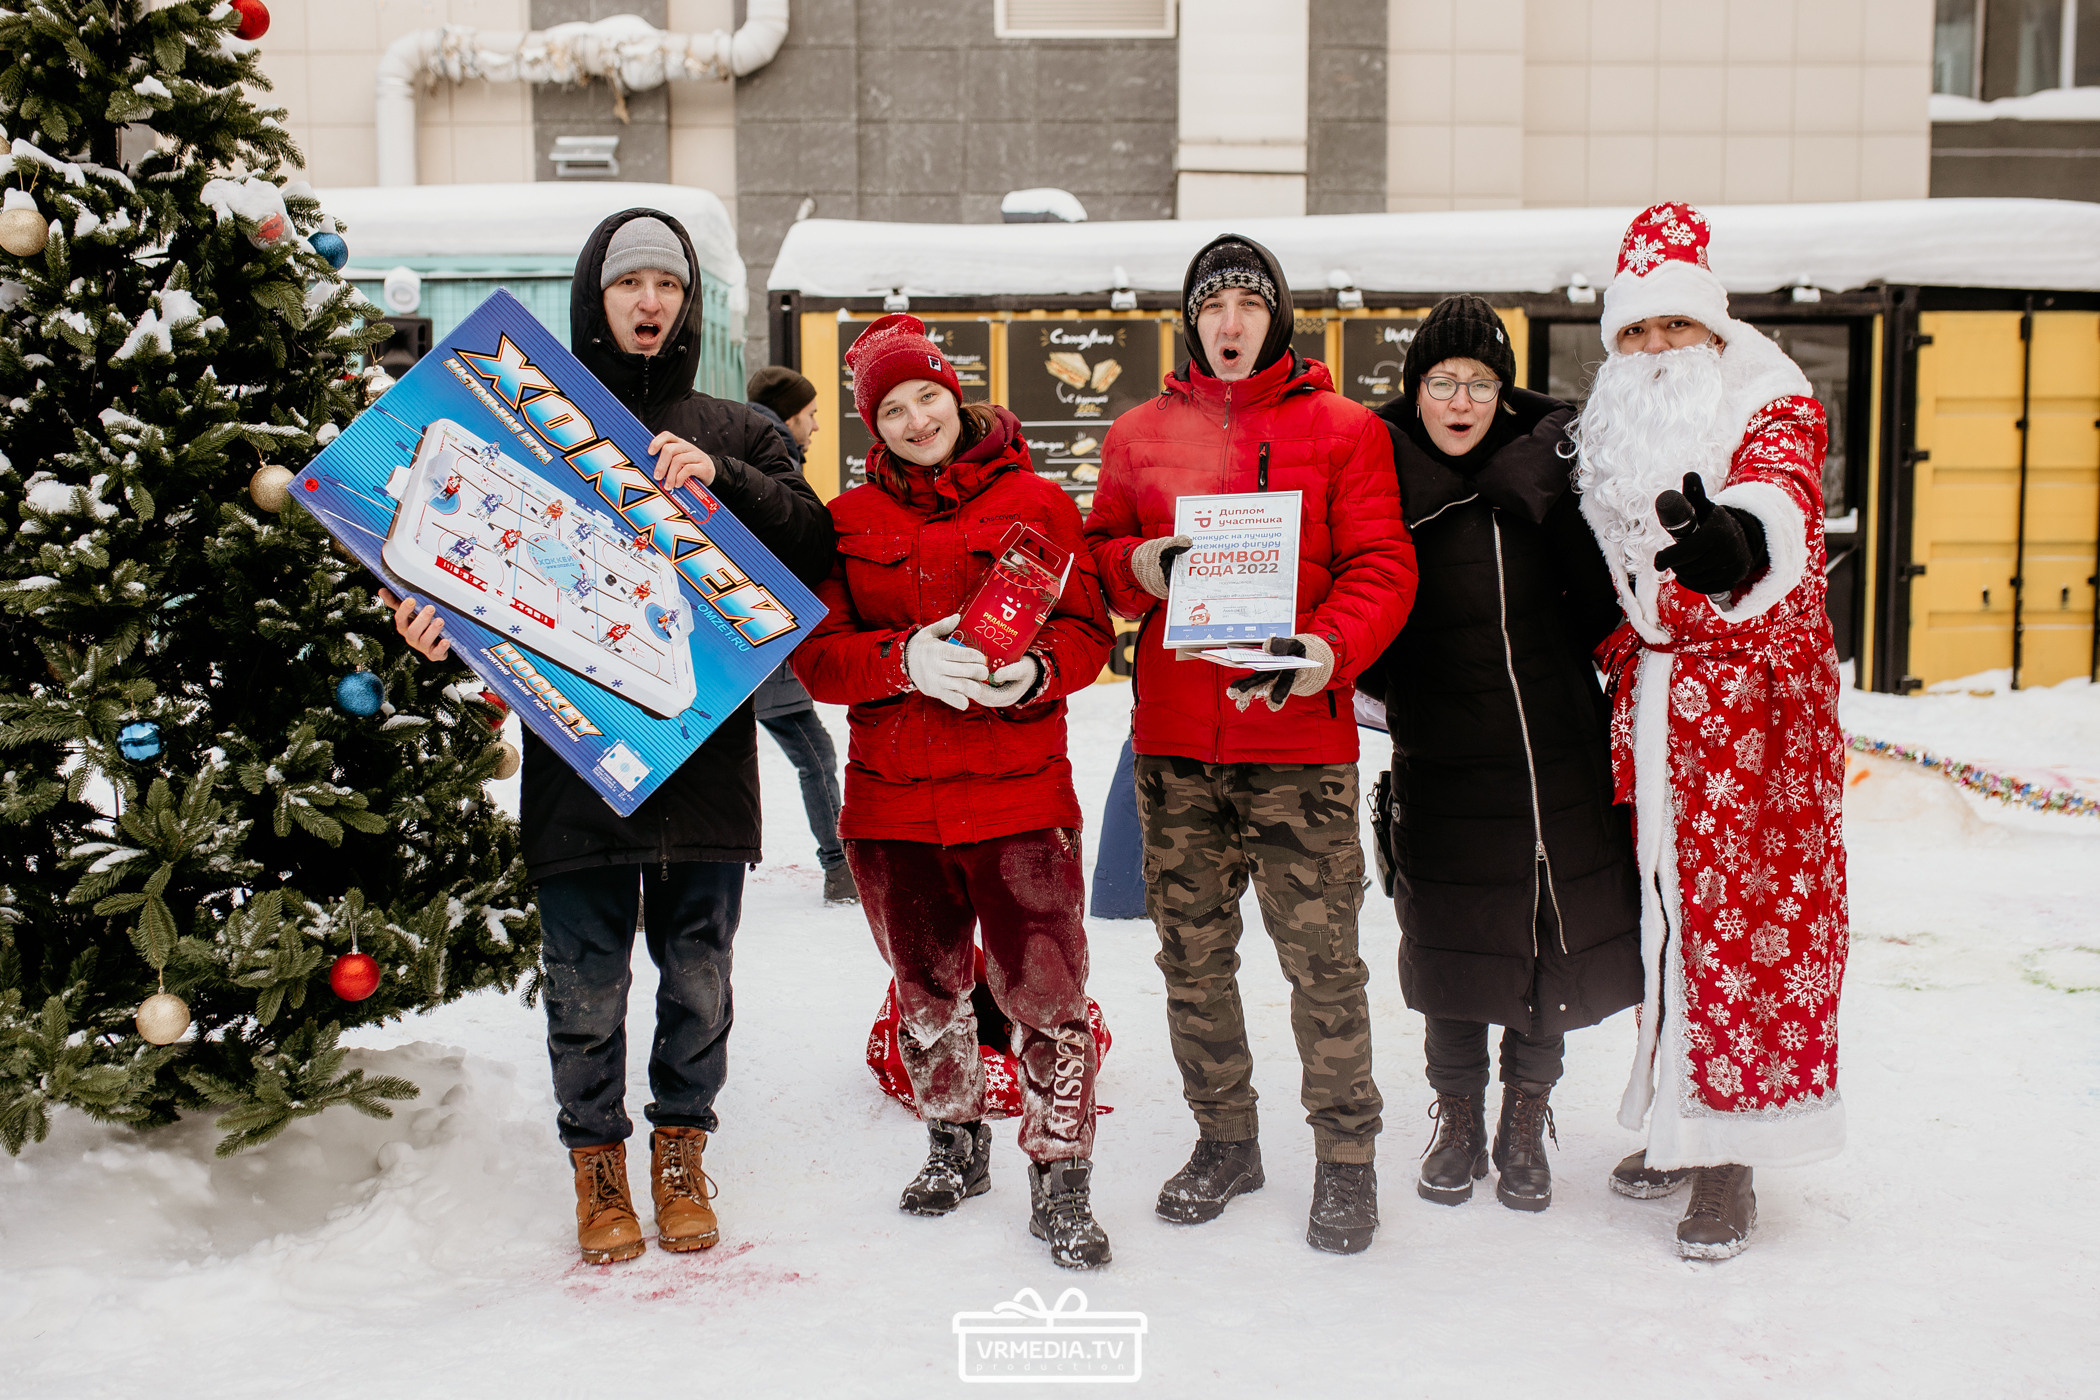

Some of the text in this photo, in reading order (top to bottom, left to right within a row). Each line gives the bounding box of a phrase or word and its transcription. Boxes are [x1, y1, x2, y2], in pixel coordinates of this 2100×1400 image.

[442, 358, 554, 465] НАСТОЛЬНАЯ ИГРА
[452, 332, 801, 648] ХОККЕЙ
[1219, 508, 1264, 516] Диплом
[1219, 517, 1282, 526] участника
[1242, 540, 1281, 549] фигуру
[1244, 532, 1282, 540] лучшую
[538, 556, 574, 566] ХОККЕЙ
[1188, 563, 1279, 577] ГОДА 2022
[697, 603, 750, 653] OMZET.RU
[974, 620, 1014, 651] 2022
[982, 611, 1019, 638] РЕДАКЦИЯ
[480, 648, 581, 743] SPORTING GAME FOR CHILDREN
[489, 641, 605, 737] HOCKEY
